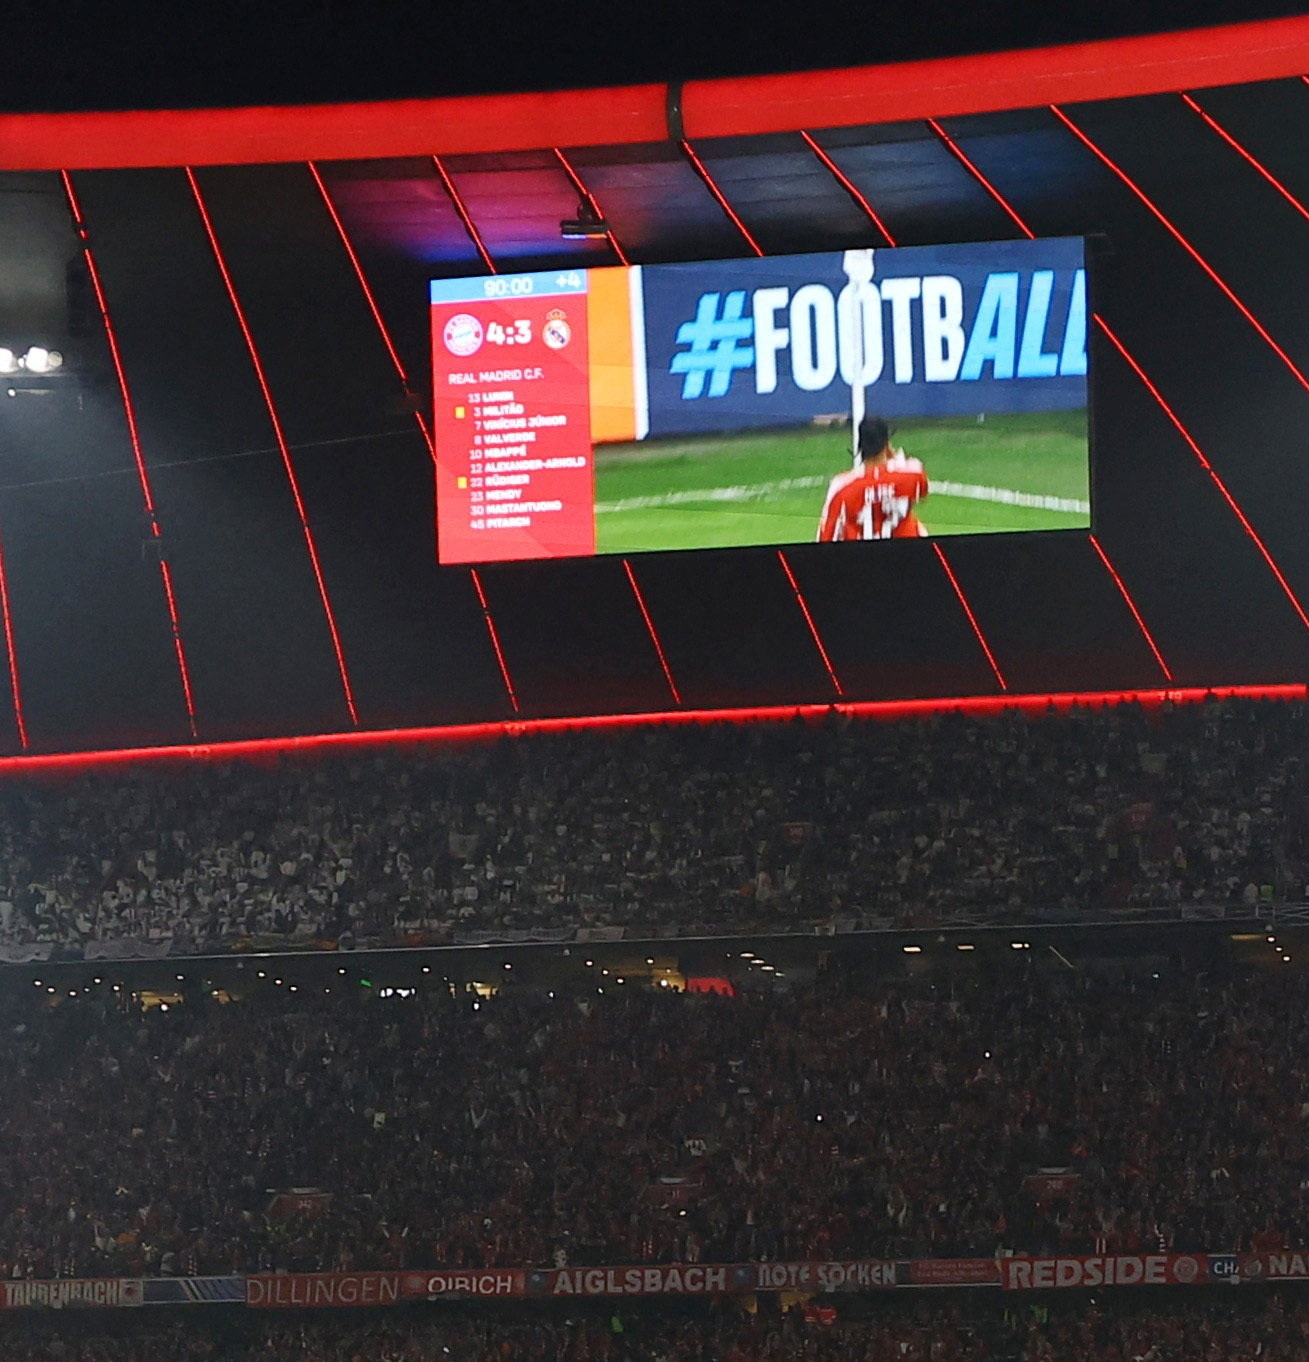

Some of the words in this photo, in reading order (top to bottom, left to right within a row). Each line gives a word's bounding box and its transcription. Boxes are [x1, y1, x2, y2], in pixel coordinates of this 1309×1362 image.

[484, 277, 533, 296] 90:00
[556, 272, 581, 288] +4
[486, 320, 532, 345] 4:3
[449, 373, 476, 384] REAL
[479, 370, 522, 382] MADRID
[475, 421, 482, 430] 7
[553, 1267, 727, 1295] AIGLSBACH
[1008, 1257, 1168, 1289] REDSIDE
[246, 1276, 399, 1305] DILLINGEN
